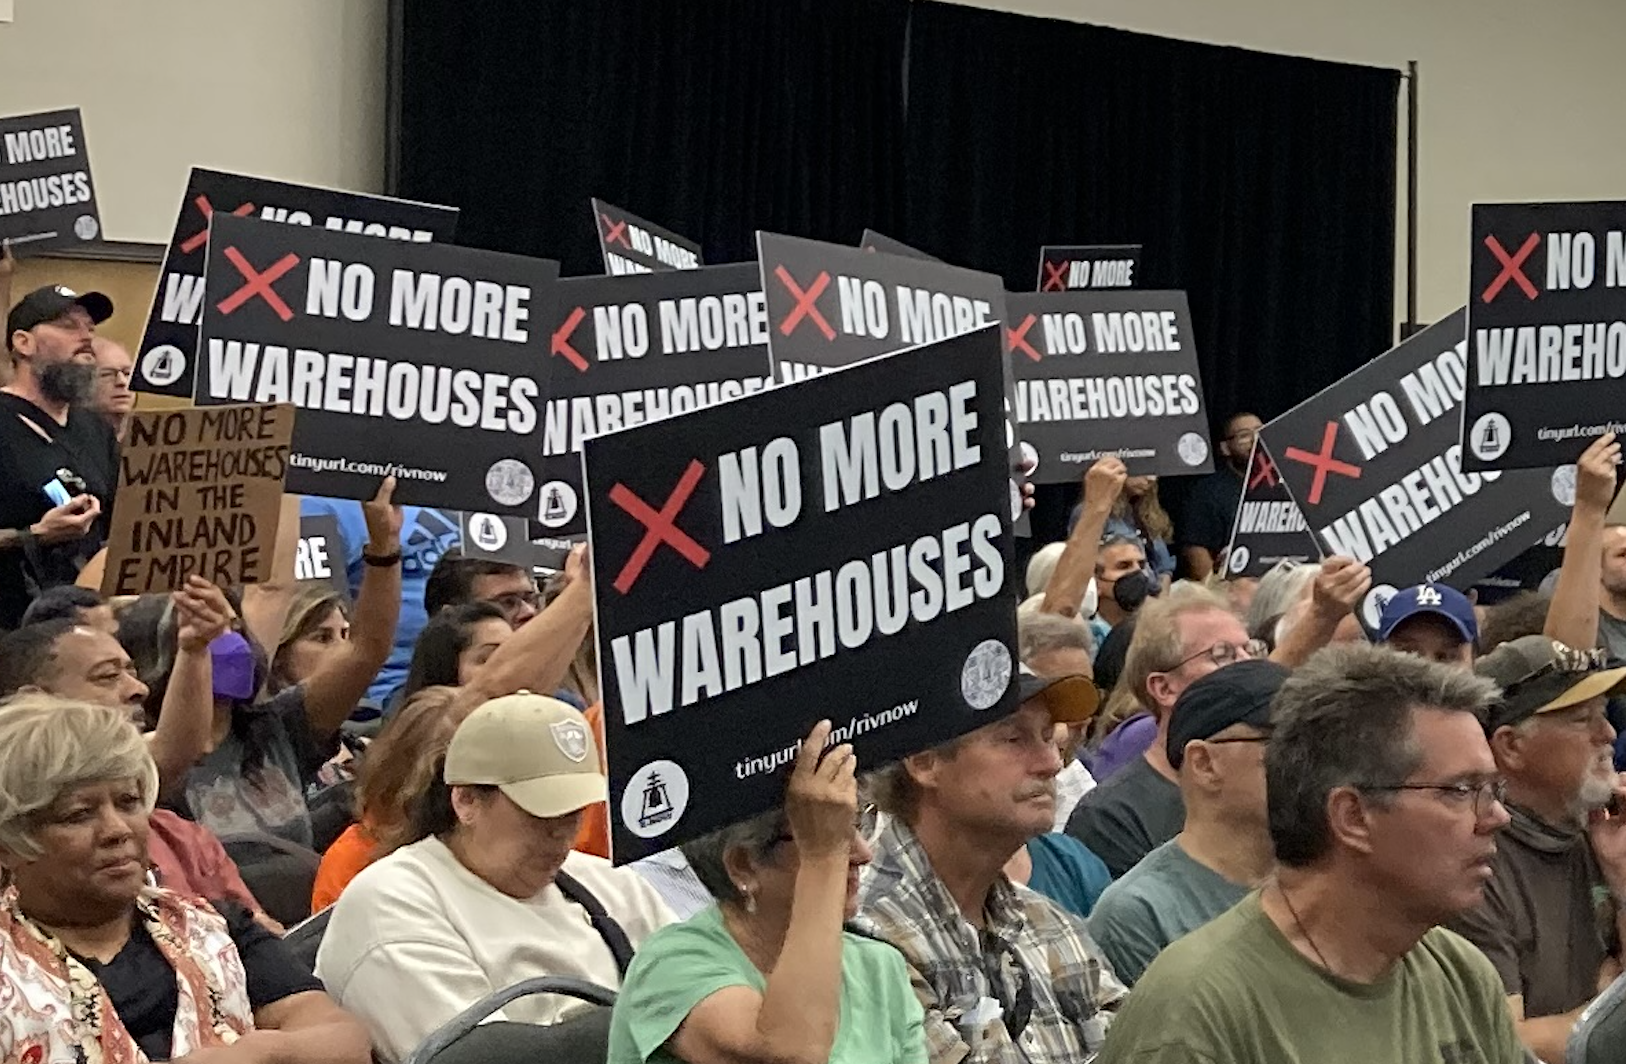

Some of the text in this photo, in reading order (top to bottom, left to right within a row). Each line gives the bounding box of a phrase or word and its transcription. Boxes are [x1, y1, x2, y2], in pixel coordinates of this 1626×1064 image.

[4, 125, 76, 164] MORE
[628, 224, 653, 256] NO
[653, 236, 698, 270] MORE
[1545, 231, 1595, 291] NO
[1068, 259, 1134, 288] NO MORE
[305, 257, 531, 343] NO MORE
[837, 275, 889, 339] NO
[593, 291, 769, 361] NO MORE
[1042, 311, 1181, 355] NO MORE
[208, 338, 539, 435] WAREHOUSES
[130, 405, 278, 447] NO MORE
[1344, 391, 1408, 461] NO
[122, 445, 288, 486] WAREHOUSES
[289, 453, 448, 483] tinyurl.com/rivnow
[719, 380, 982, 544] NO MORE
[143, 484, 245, 514] IN THE
[131, 513, 257, 552] INLAND
[1426, 510, 1531, 584] tinyurl.com/rivnow
[114, 546, 261, 596] EMPIRE
[1416, 583, 1442, 606] LA
[611, 513, 1005, 725] WAREHOUSES
